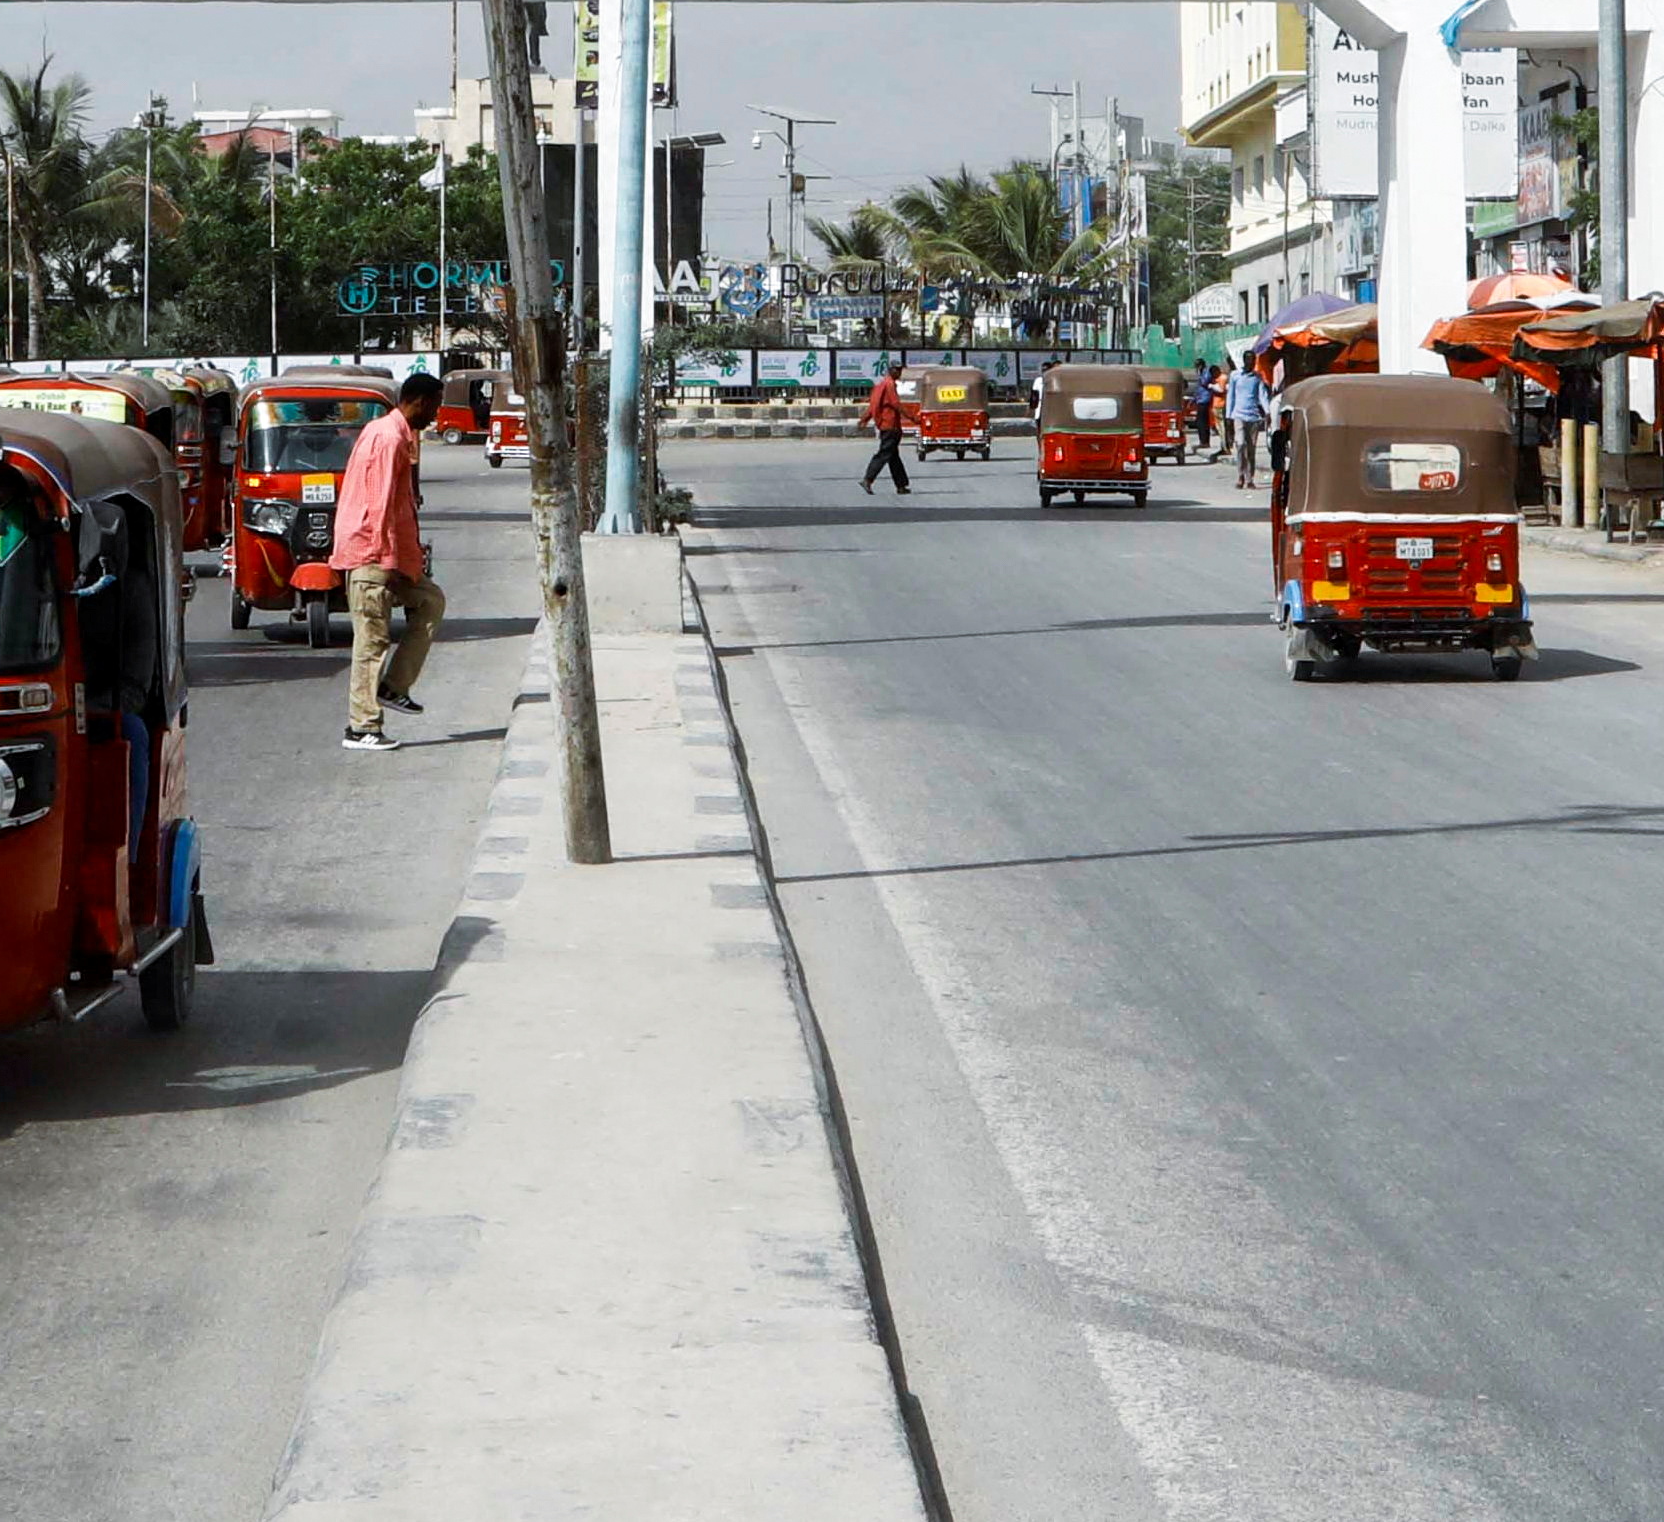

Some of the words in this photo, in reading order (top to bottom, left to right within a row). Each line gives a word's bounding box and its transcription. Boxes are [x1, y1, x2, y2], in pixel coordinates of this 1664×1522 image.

[1337, 72, 1379, 84] Mush
[1461, 72, 1504, 85] ibaan
[940, 389, 965, 398] TAXI
